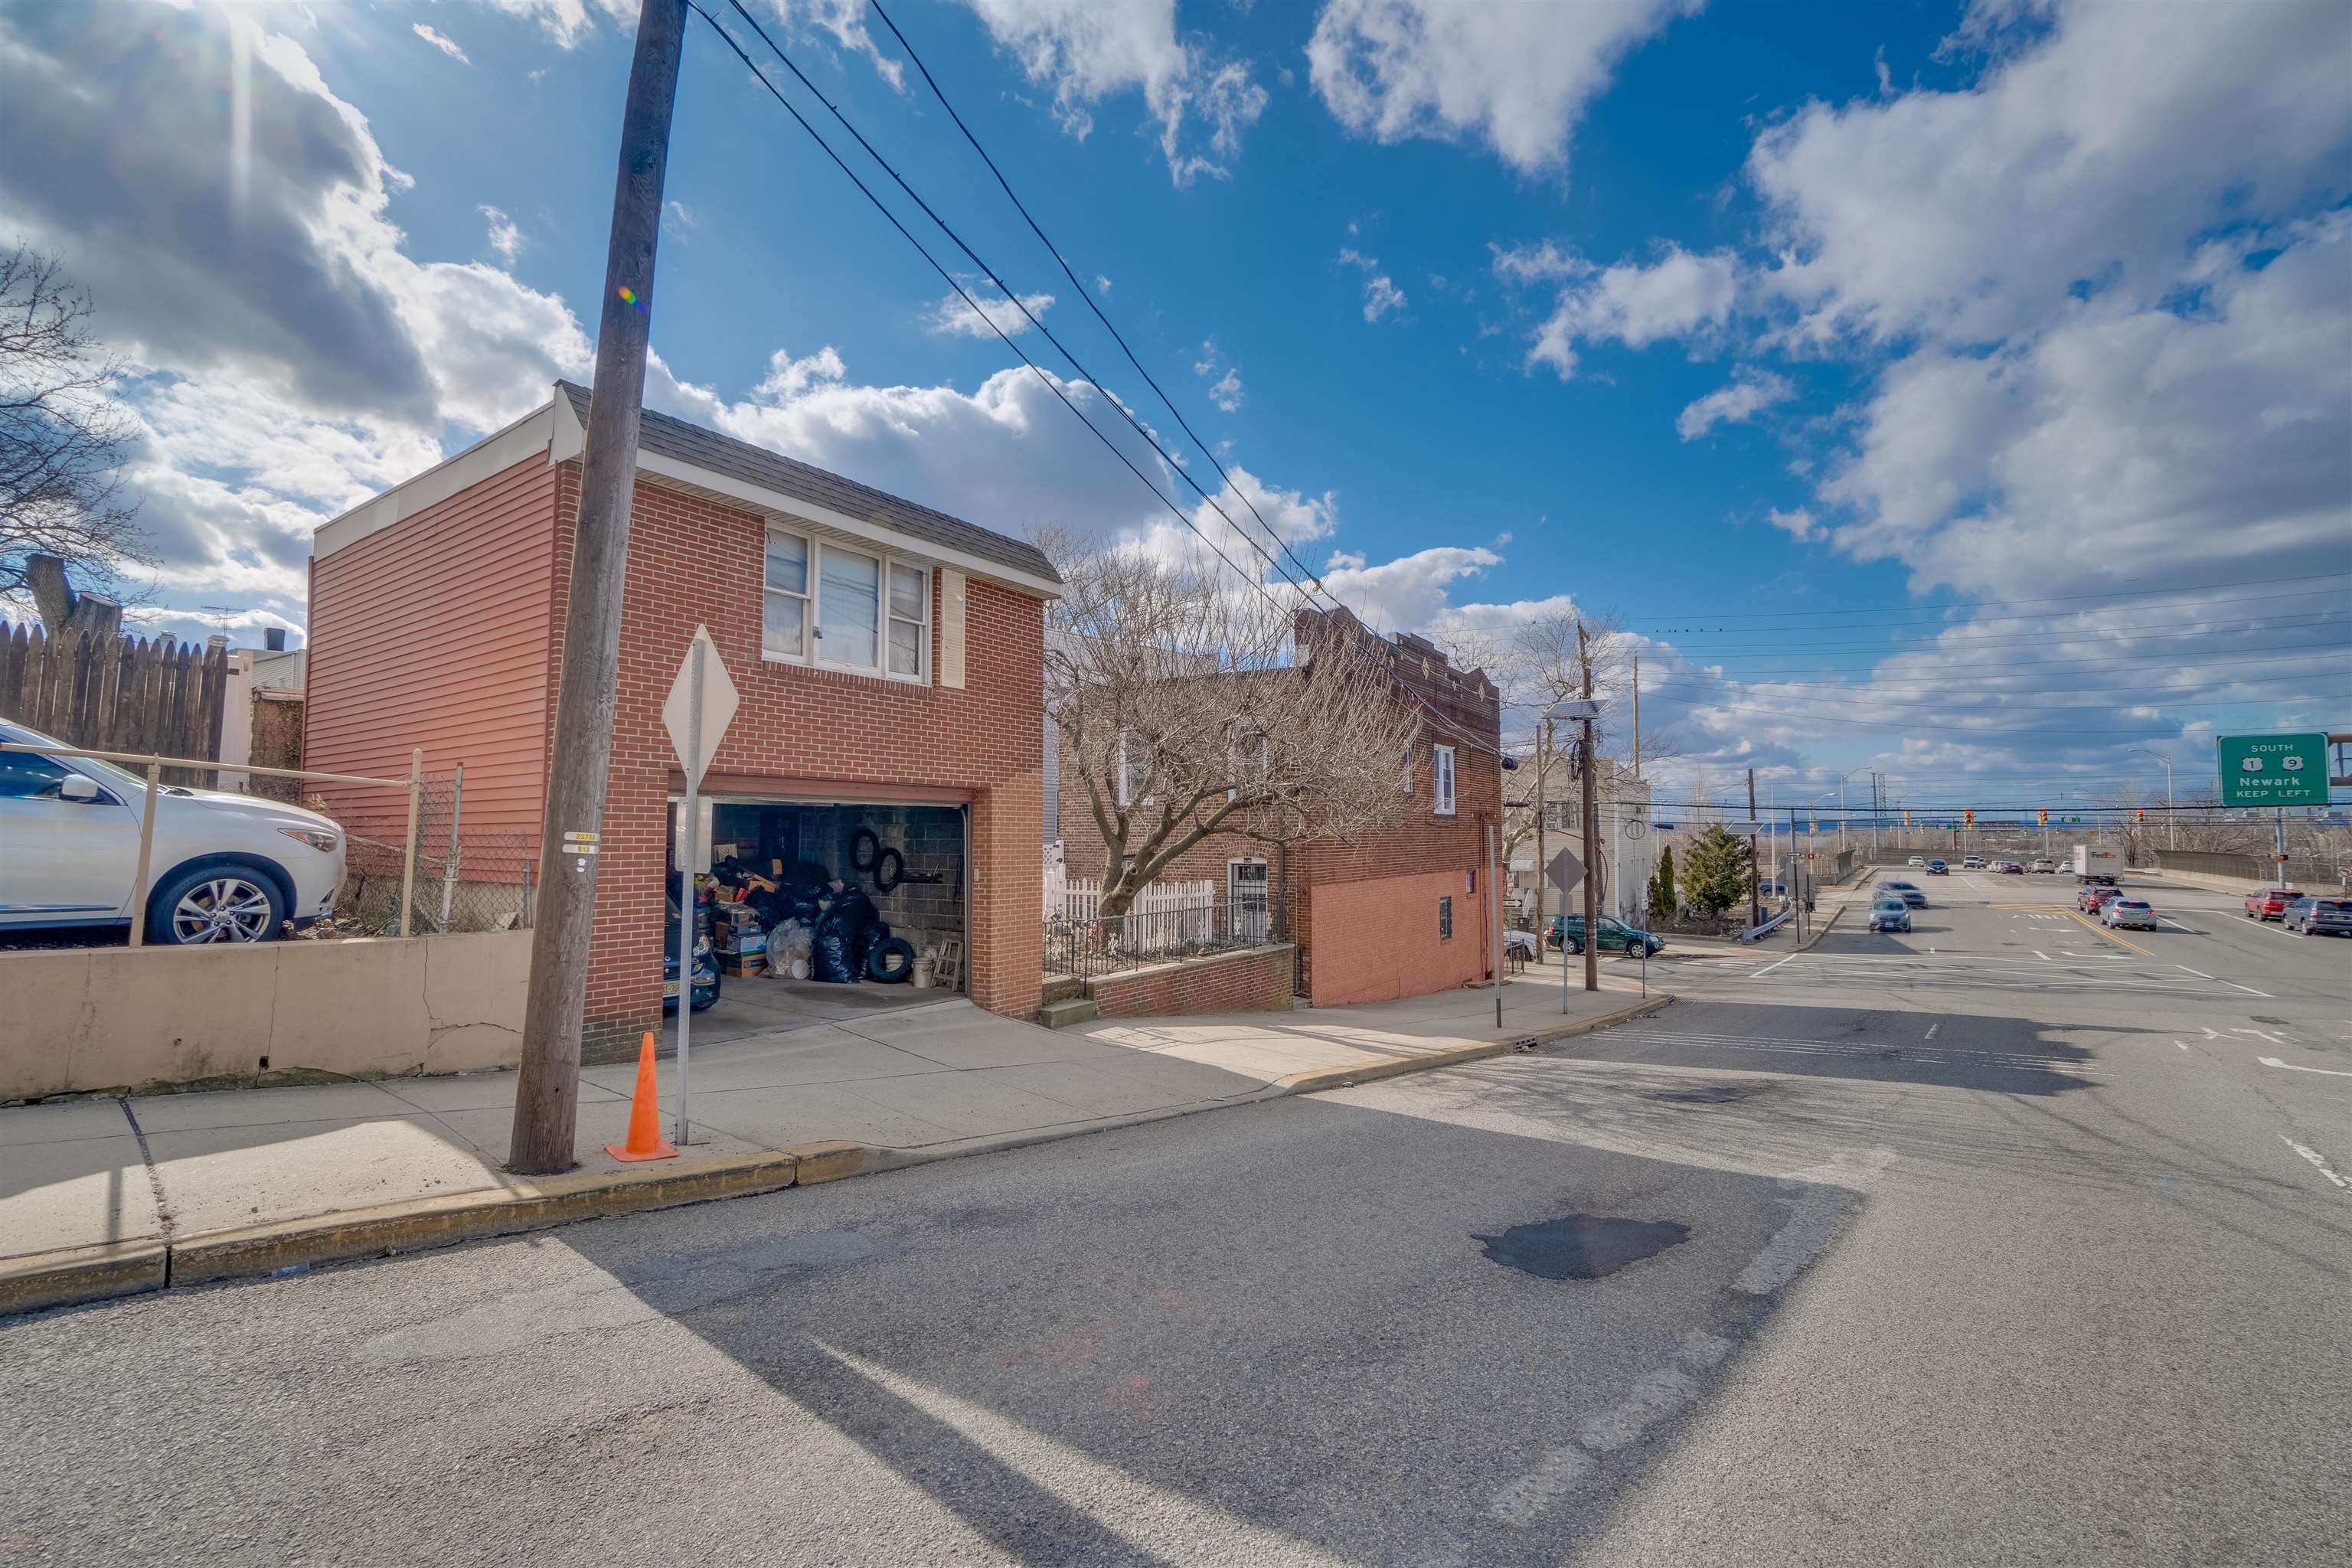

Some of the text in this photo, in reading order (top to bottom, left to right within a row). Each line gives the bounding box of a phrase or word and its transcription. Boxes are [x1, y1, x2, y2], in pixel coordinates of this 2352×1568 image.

[2251, 744, 2293, 753] SOUTH
[2249, 760, 2297, 769] 1 9
[2239, 776, 2301, 786] Newark
